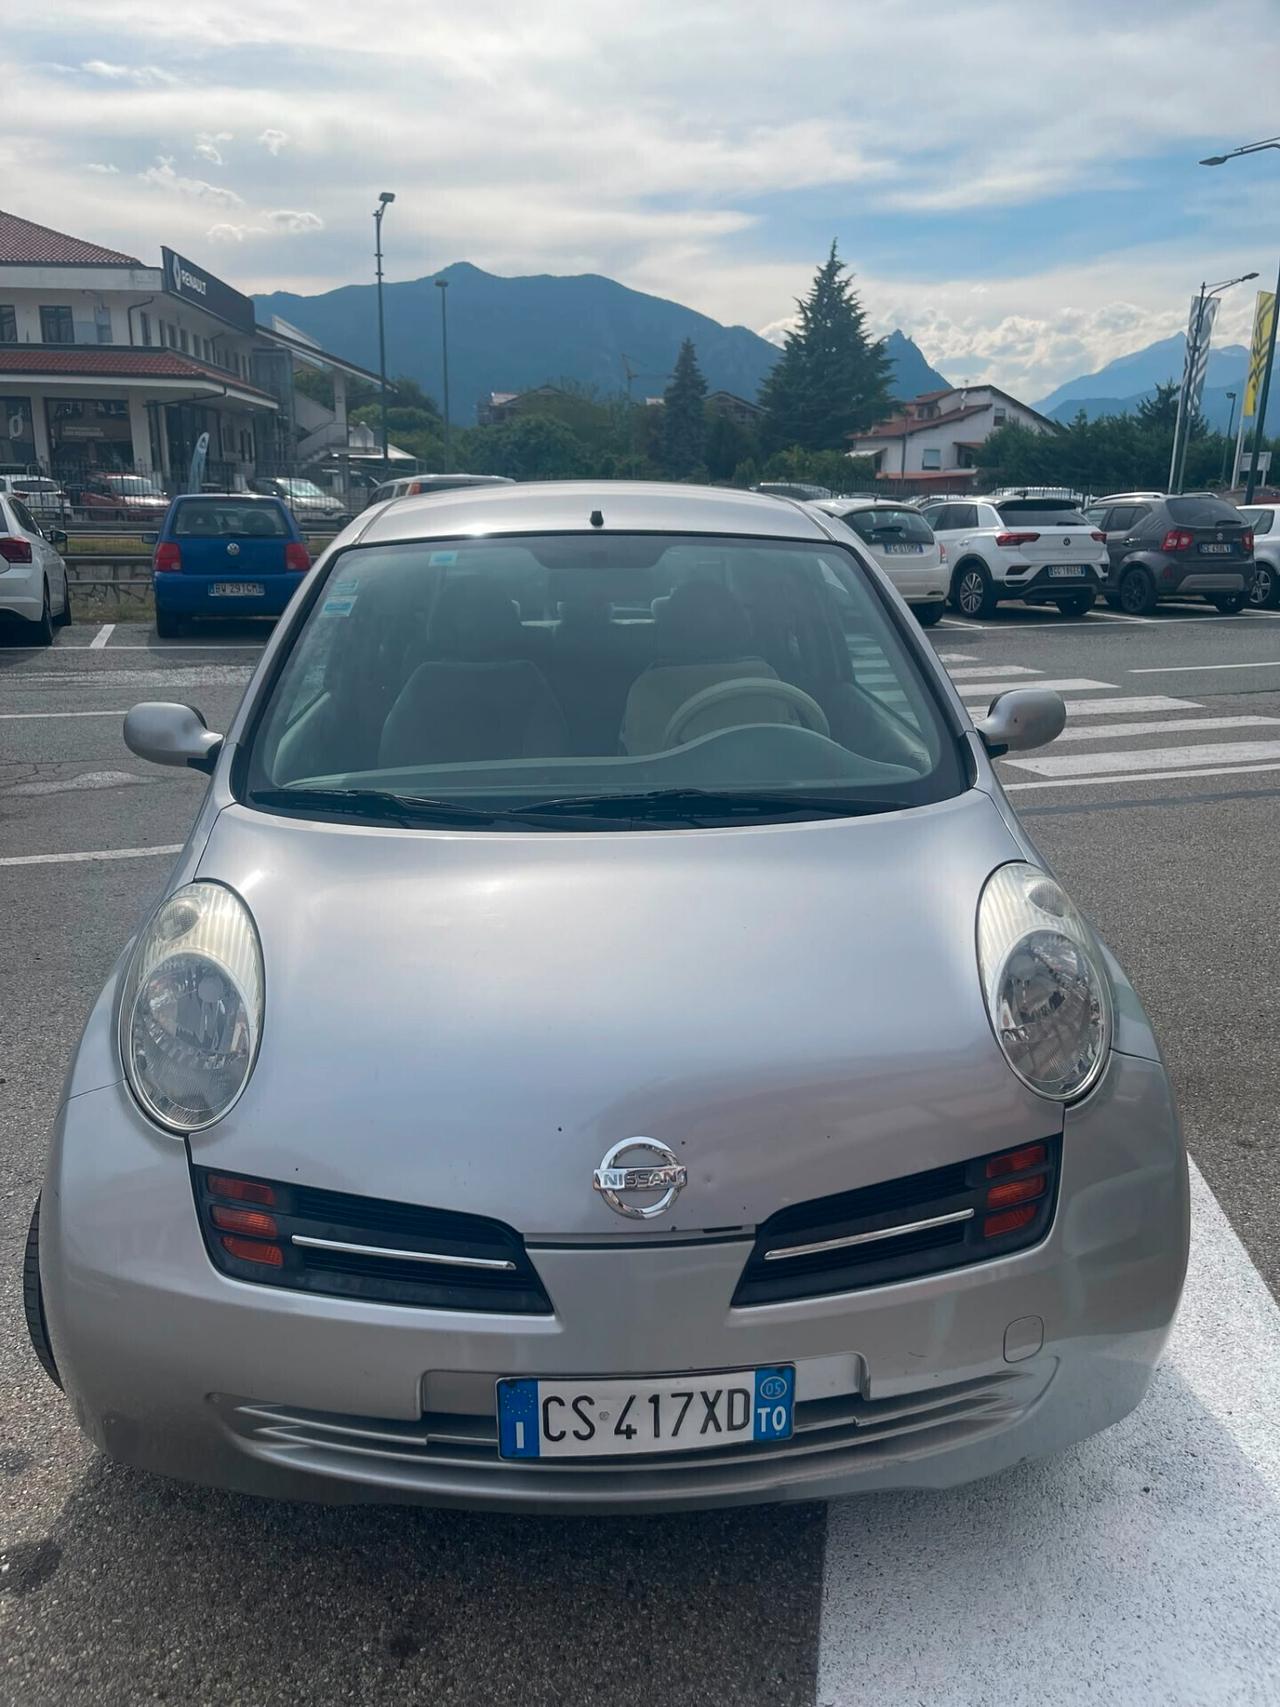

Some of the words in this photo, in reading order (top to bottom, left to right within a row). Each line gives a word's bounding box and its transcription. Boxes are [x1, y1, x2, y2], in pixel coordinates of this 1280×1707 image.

[603, 1171, 677, 1187] NISSAN
[765, 1382, 781, 1395] 05
[515, 1421, 524, 1448] I
[542, 1395, 595, 1442] CS
[614, 1388, 750, 1440] 417XD
[757, 1406, 786, 1433] TO
